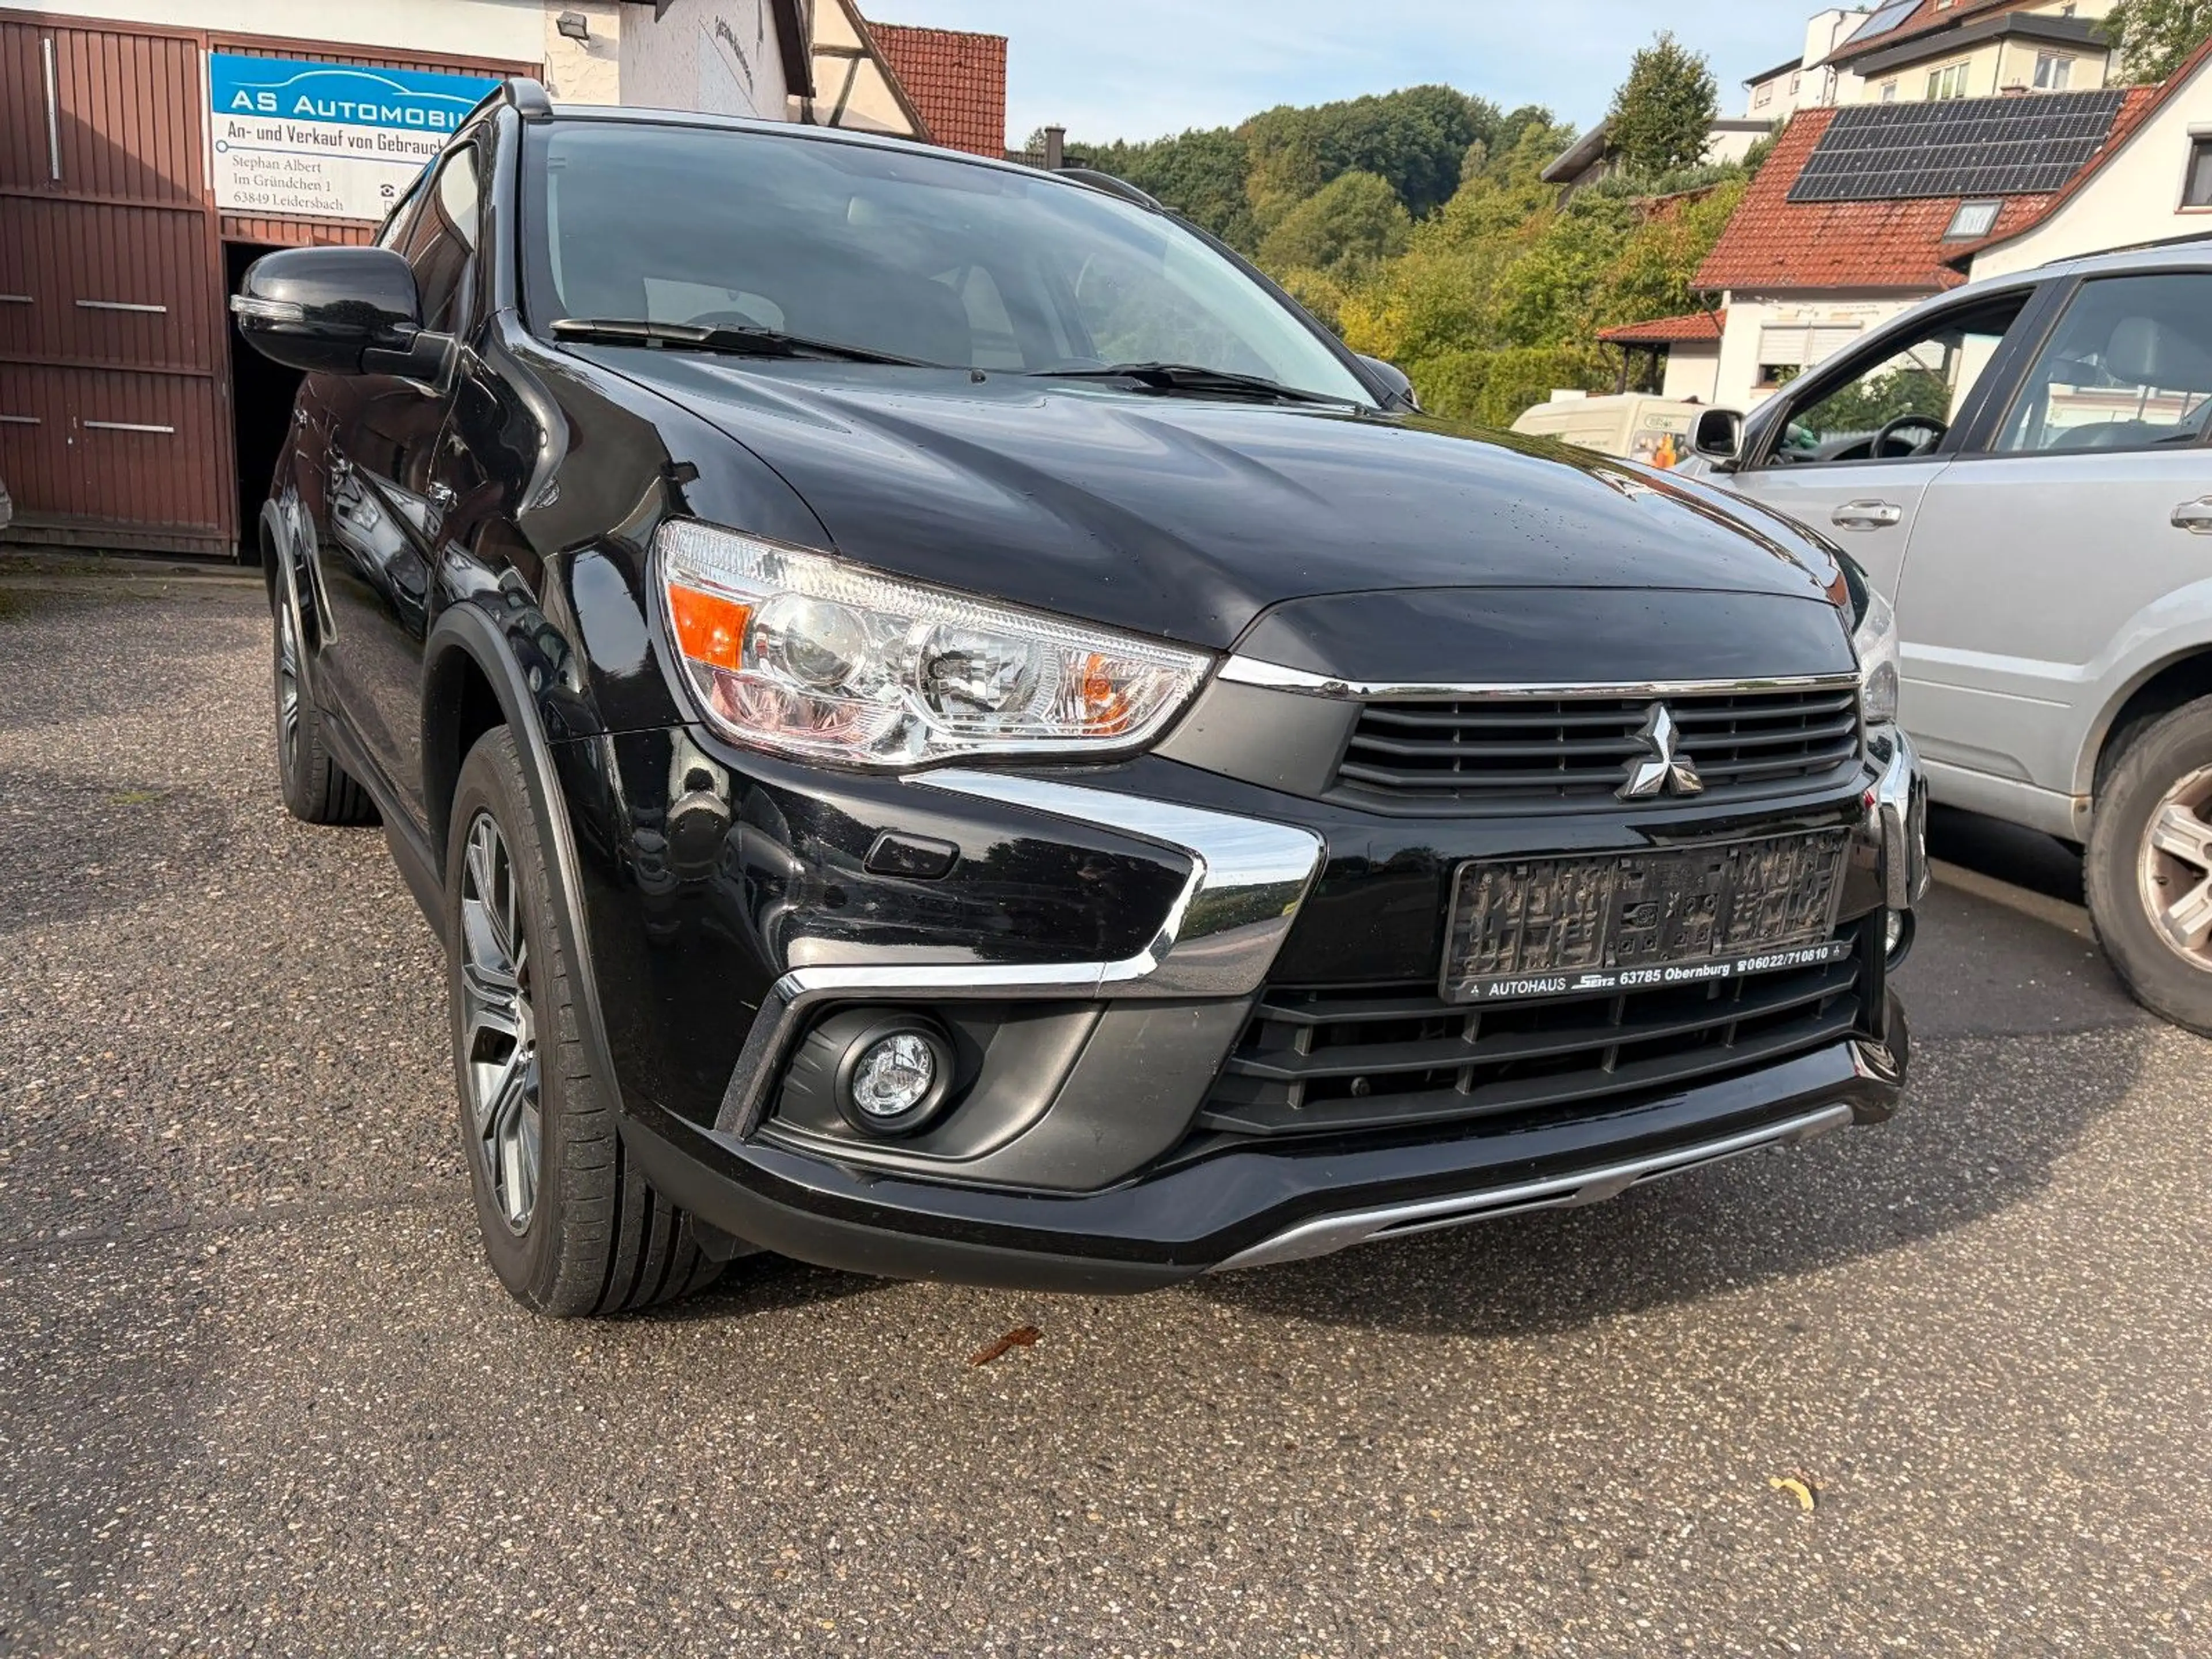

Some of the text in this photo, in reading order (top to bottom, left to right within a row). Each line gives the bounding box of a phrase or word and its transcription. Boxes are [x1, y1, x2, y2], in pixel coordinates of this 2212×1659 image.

[231, 90, 277, 112] AS
[228, 121, 252, 139] An-
[257, 125, 282, 142] und
[287, 125, 343, 147] Verkauf
[348, 135, 373, 149] von
[232, 155, 321, 173] Stephan Albert
[233, 173, 331, 191] Im Gründchen 1
[233, 191, 344, 211] 63849 Leidersbach
[1488, 978, 1566, 996] AUTOHAUS
[1620, 969, 1661, 985] 63785
[1665, 964, 1730, 980] Obernburg
[1747, 947, 1829, 971] 06022/710810
